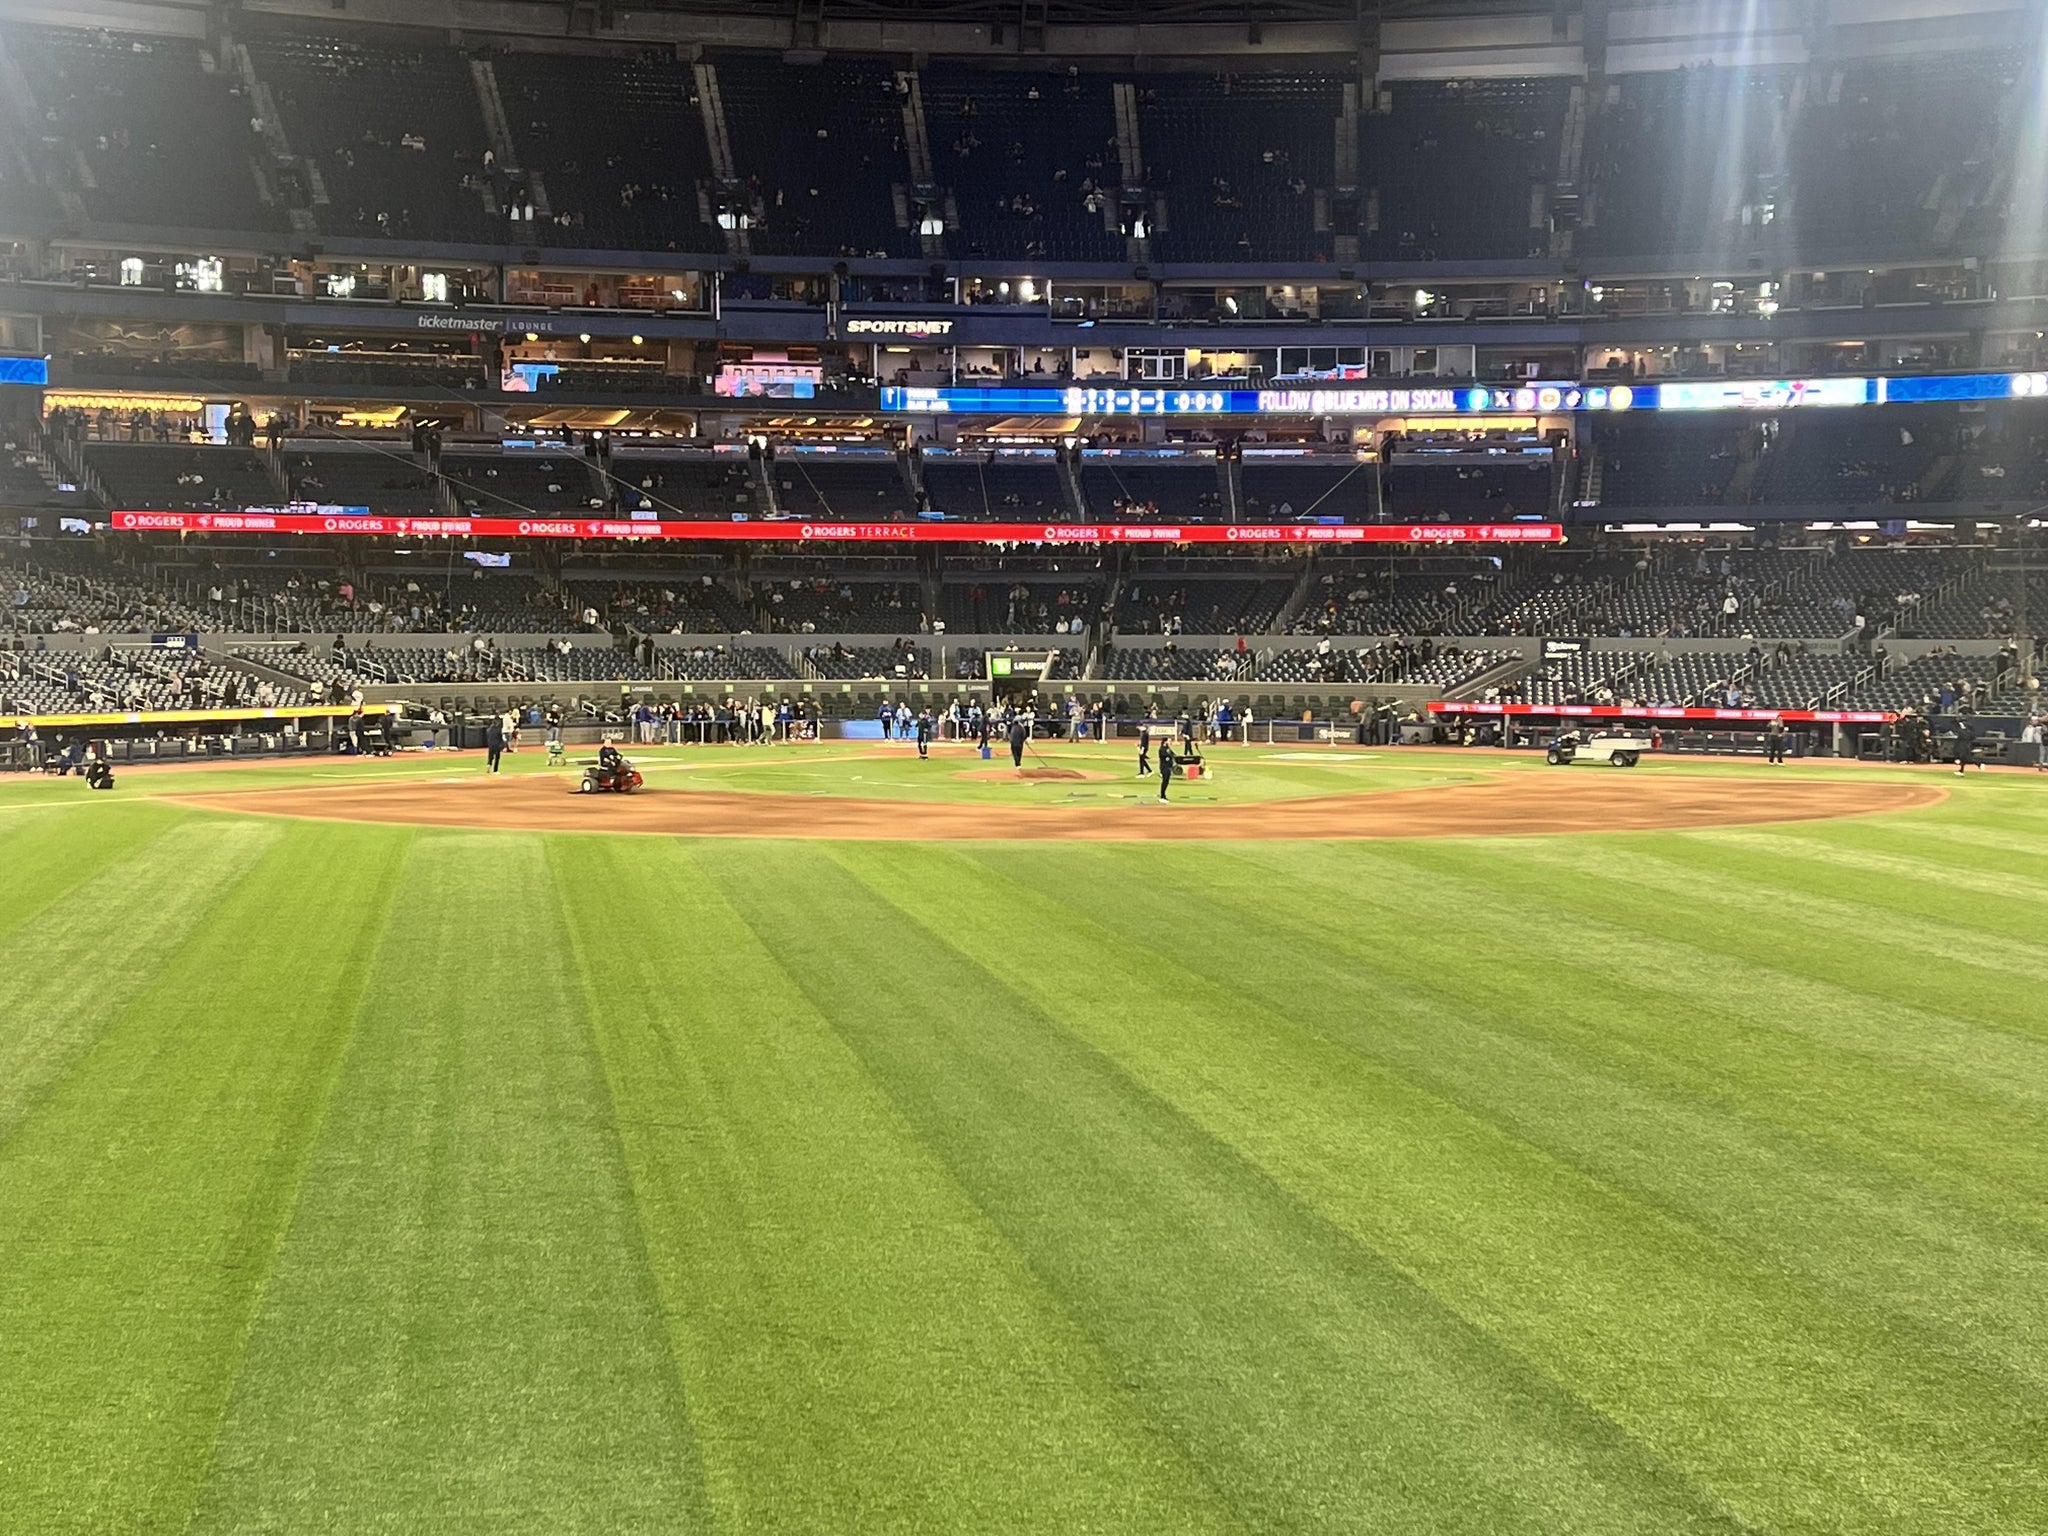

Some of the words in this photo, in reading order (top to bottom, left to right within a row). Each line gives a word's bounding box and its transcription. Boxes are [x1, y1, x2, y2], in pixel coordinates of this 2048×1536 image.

[418, 315, 498, 330] ticketmaster
[512, 322, 552, 331] LOUNGE
[847, 320, 953, 334] SPORTSNET
[1258, 391, 1310, 410] FOLLOW
[1312, 390, 1388, 412] @BLUEJAYS
[1391, 391, 1409, 409] ON
[1412, 389, 1457, 409] SOCIAL
[138, 516, 184, 526] ROGERS
[213, 517, 243, 528] PROUD
[245, 518, 276, 528] OWNER
[338, 520, 383, 530] ROGERS
[411, 521, 440, 531] PROUD
[441, 521, 472, 532] OWNER
[532, 523, 576, 533] ROGERS
[814, 527, 856, 537] ROGERS
[859, 527, 915, 537] TERRACE
[1057, 528, 1098, 538] ROGERS
[1239, 529, 1280, 538] ROGERS
[1423, 528, 1466, 538] ROGERS
